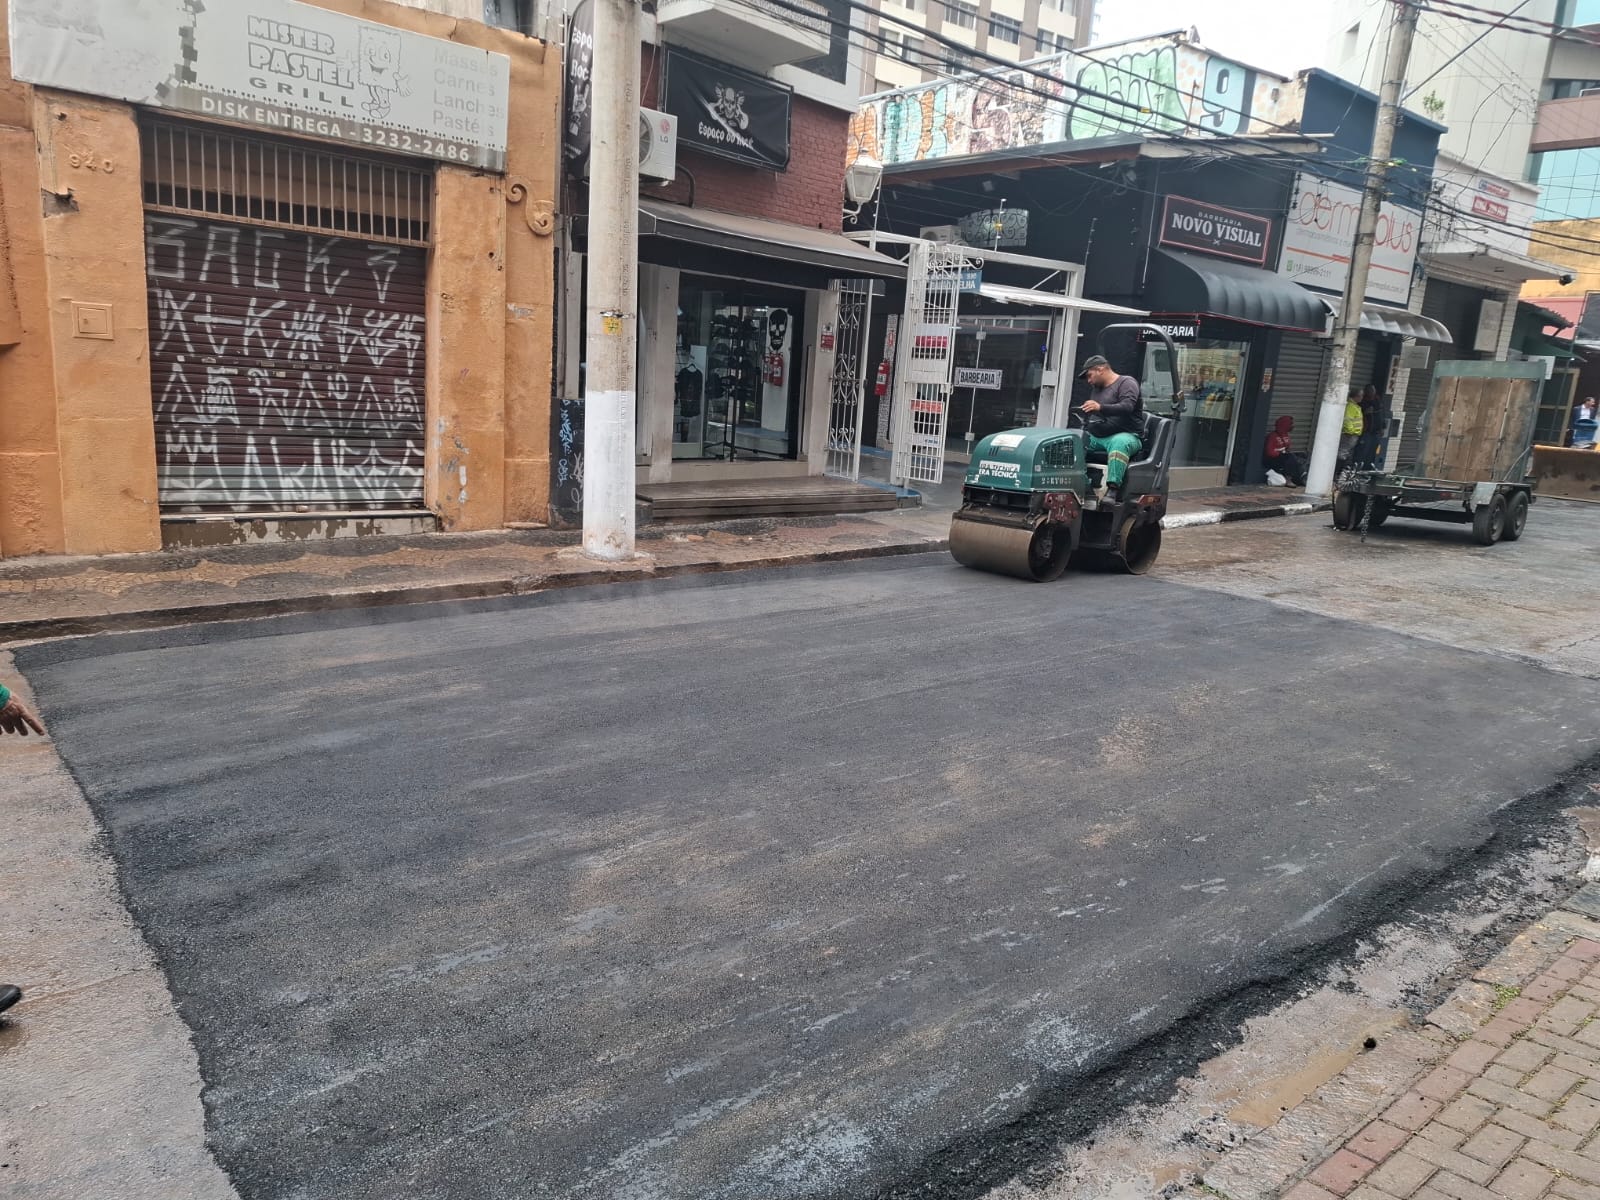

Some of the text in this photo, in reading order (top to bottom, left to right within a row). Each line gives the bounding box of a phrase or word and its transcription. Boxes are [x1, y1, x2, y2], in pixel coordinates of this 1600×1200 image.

[247, 15, 335, 55] MISTER
[247, 42, 354, 90] PASTEL
[249, 77, 354, 108] GRILL
[202, 96, 249, 120] DISK
[255, 105, 342, 138] ENTREGA
[362, 128, 470, 161] 3232-2486
[433, 109, 494, 136] Pastés
[698, 121, 725, 143] Espaço
[1171, 213, 1262, 247] NOVO VISUAL
[1198, 211, 1242, 226] BARBEARIA
[960, 371, 995, 384] BARBEARIA
